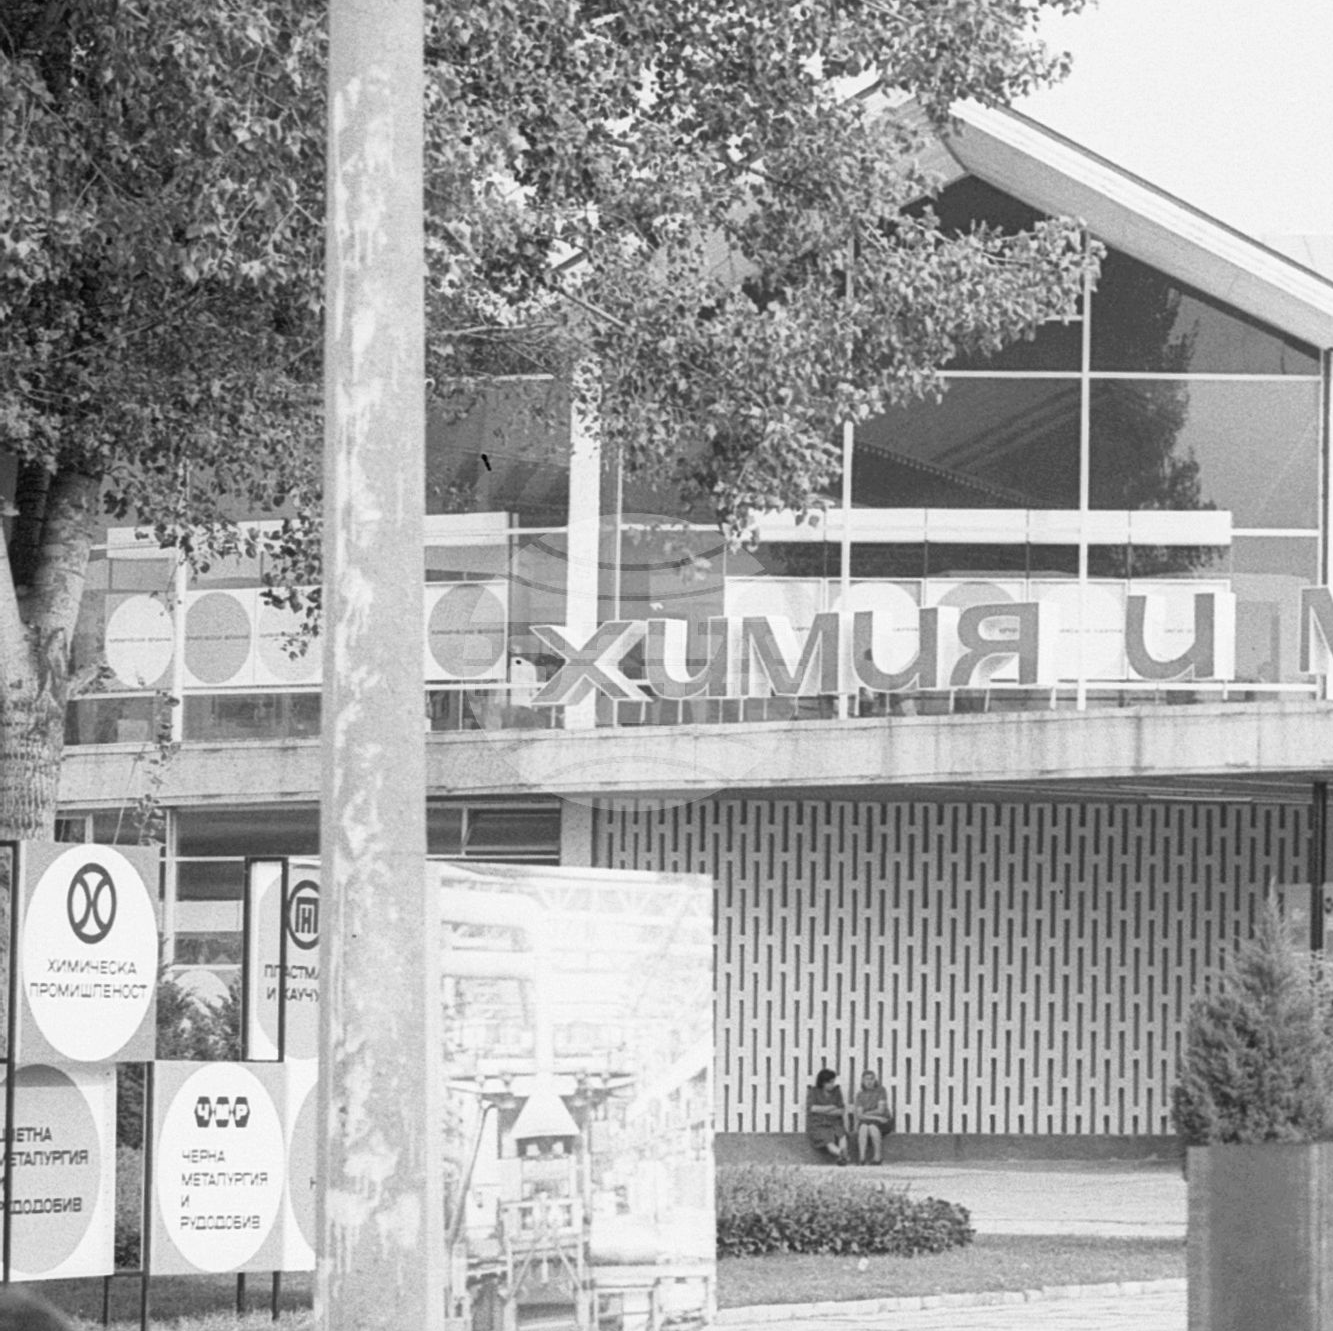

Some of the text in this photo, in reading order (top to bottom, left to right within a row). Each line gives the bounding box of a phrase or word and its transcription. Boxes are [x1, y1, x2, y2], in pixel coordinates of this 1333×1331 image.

[529, 601, 1043, 705] химия
[1123, 591, 1224, 680] и
[47, 958, 137, 976] ХИМИЧЕСКА
[29, 982, 148, 999] ПРОМИШЛЕНОСТ
[0, 1126, 52, 1143] ЕТНА
[0, 1149, 89, 1167] ЕТАЛУРГИЯ
[182, 1149, 226, 1163] ЧЕРНА
[181, 1172, 269, 1187] МЕТАЛУРГИЯ
[0, 1197, 83, 1215] ДОДОБИВ
[180, 1194, 190, 1209] И
[180, 1215, 262, 1231] РУДОДОБИВ
